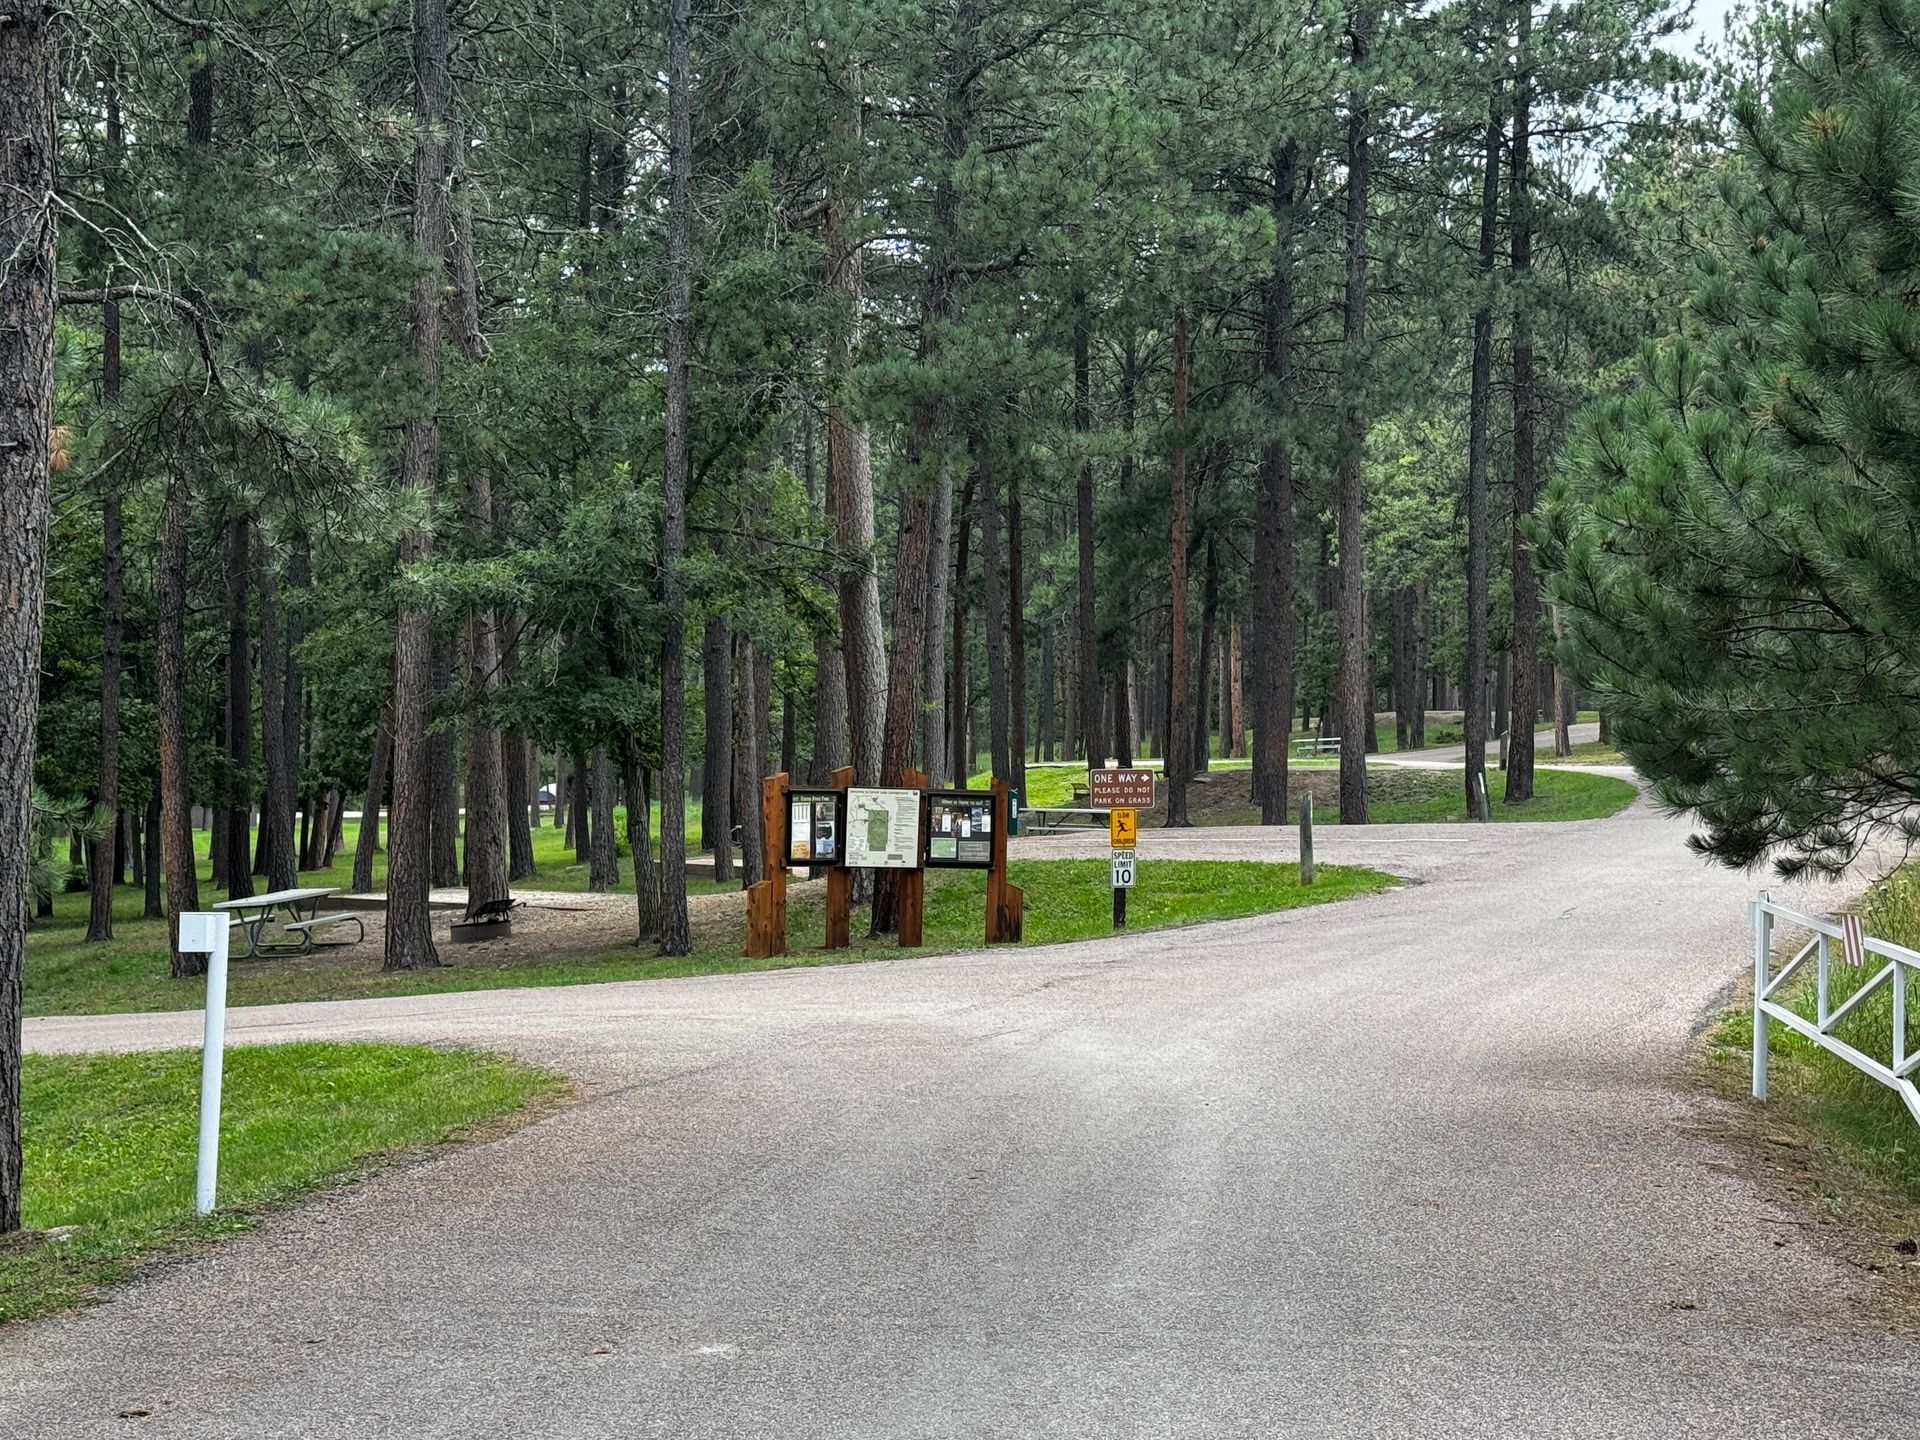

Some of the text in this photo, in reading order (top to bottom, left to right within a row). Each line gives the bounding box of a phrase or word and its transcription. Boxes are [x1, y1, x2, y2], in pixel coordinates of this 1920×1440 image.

[1094, 773, 1137, 784] ONE WAY
[1094, 786, 1120, 794] PLEASE
[1124, 786, 1134, 794] DO
[1113, 851, 1133, 860] SPEED
[1115, 869, 1131, 884] 10
